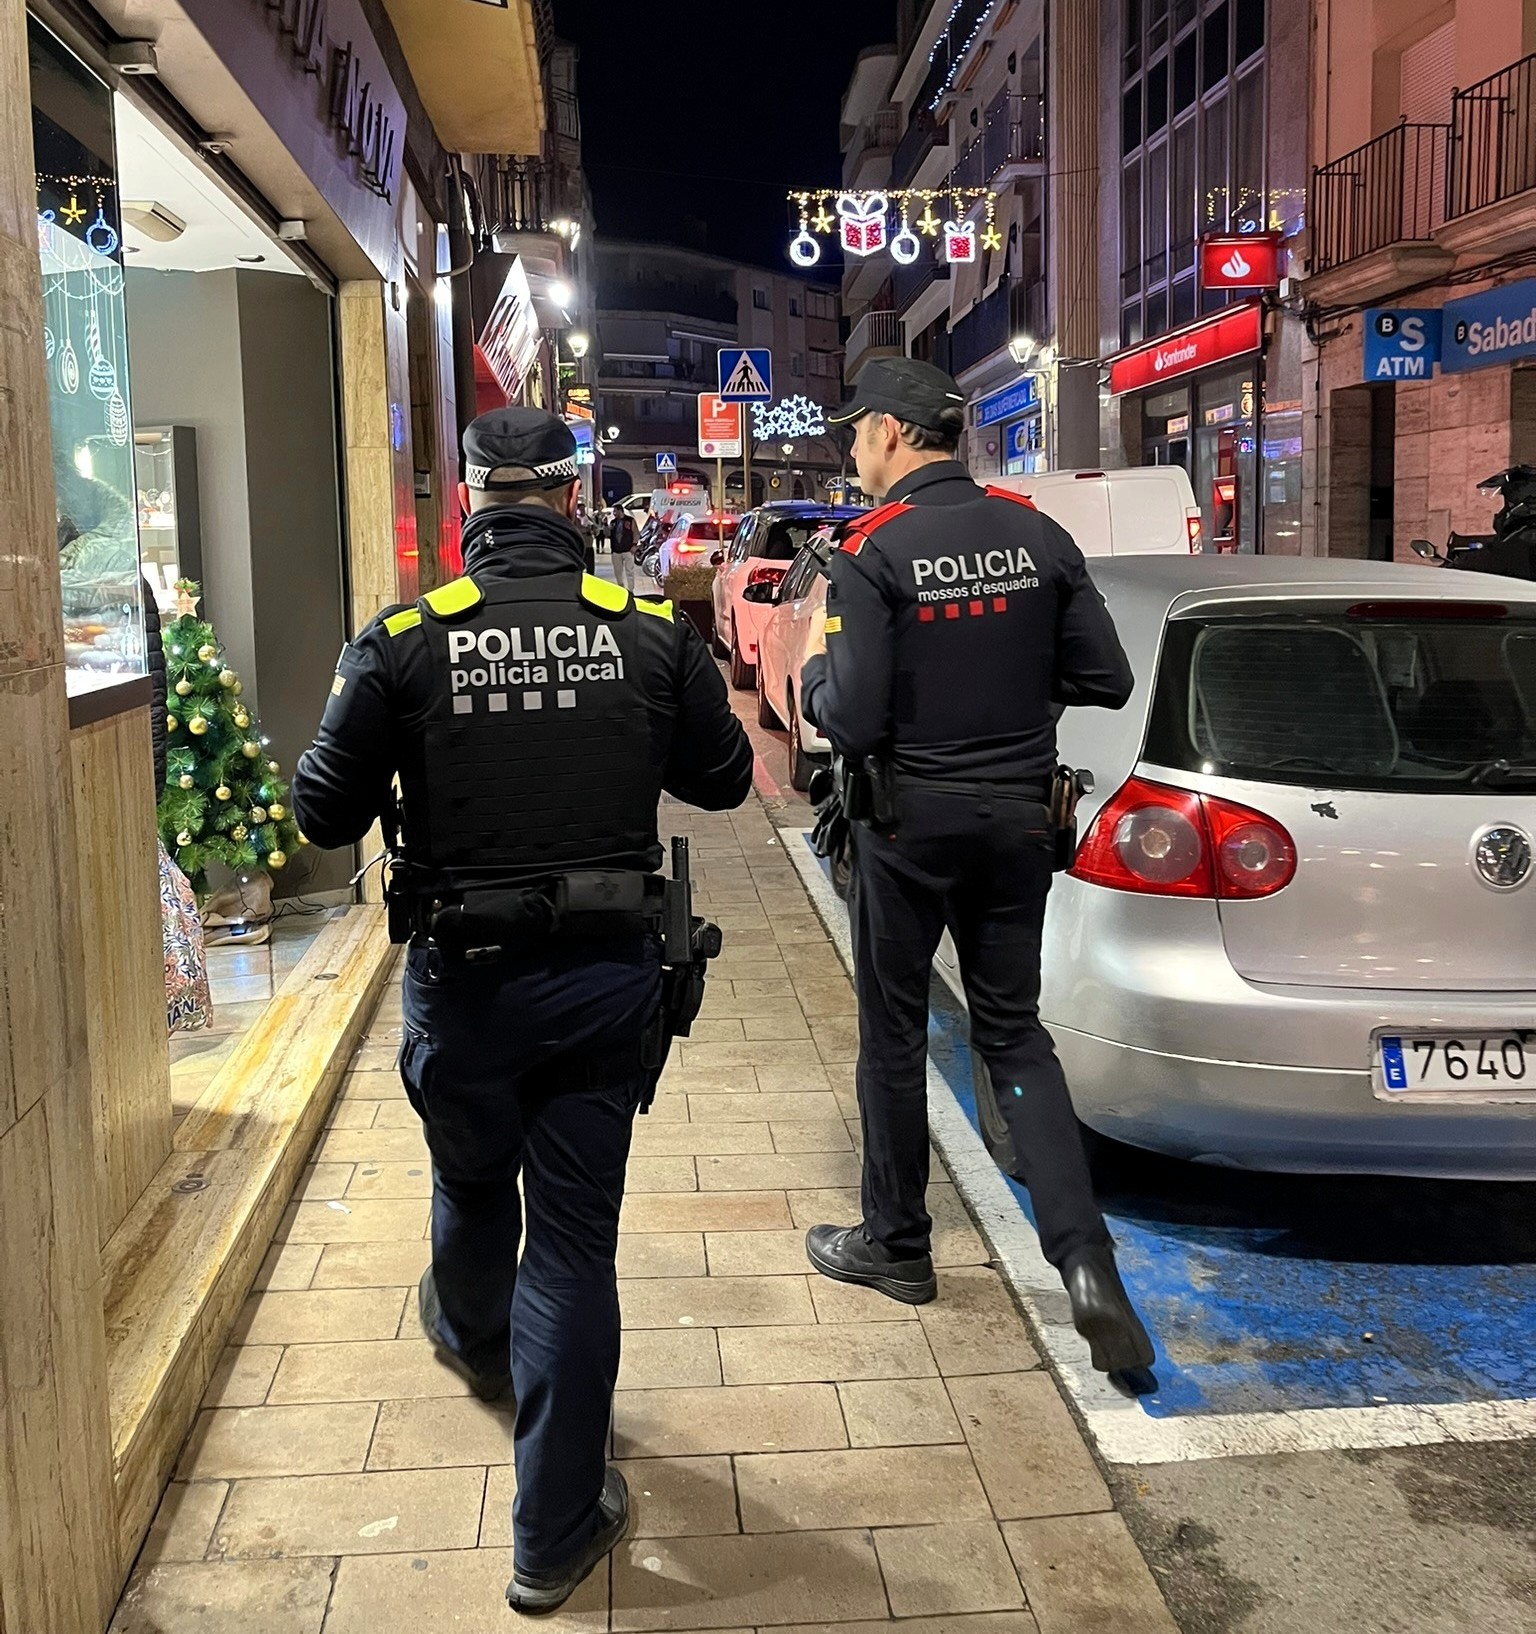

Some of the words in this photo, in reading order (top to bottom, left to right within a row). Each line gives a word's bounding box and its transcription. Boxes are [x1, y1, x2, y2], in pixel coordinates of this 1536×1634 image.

[1163, 343, 1197, 369] Santander
[1376, 356, 1424, 376] ATM
[712, 399, 727, 419] P
[911, 546, 1037, 585] POLICIA
[918, 586, 969, 602] mossos
[971, 575, 1039, 594] d'esquadra
[448, 624, 622, 663] POLICIA
[451, 661, 548, 693] policia
[557, 657, 624, 682] local
[1390, 1068, 1402, 1080] E
[1413, 1039, 1526, 1080] 7640
